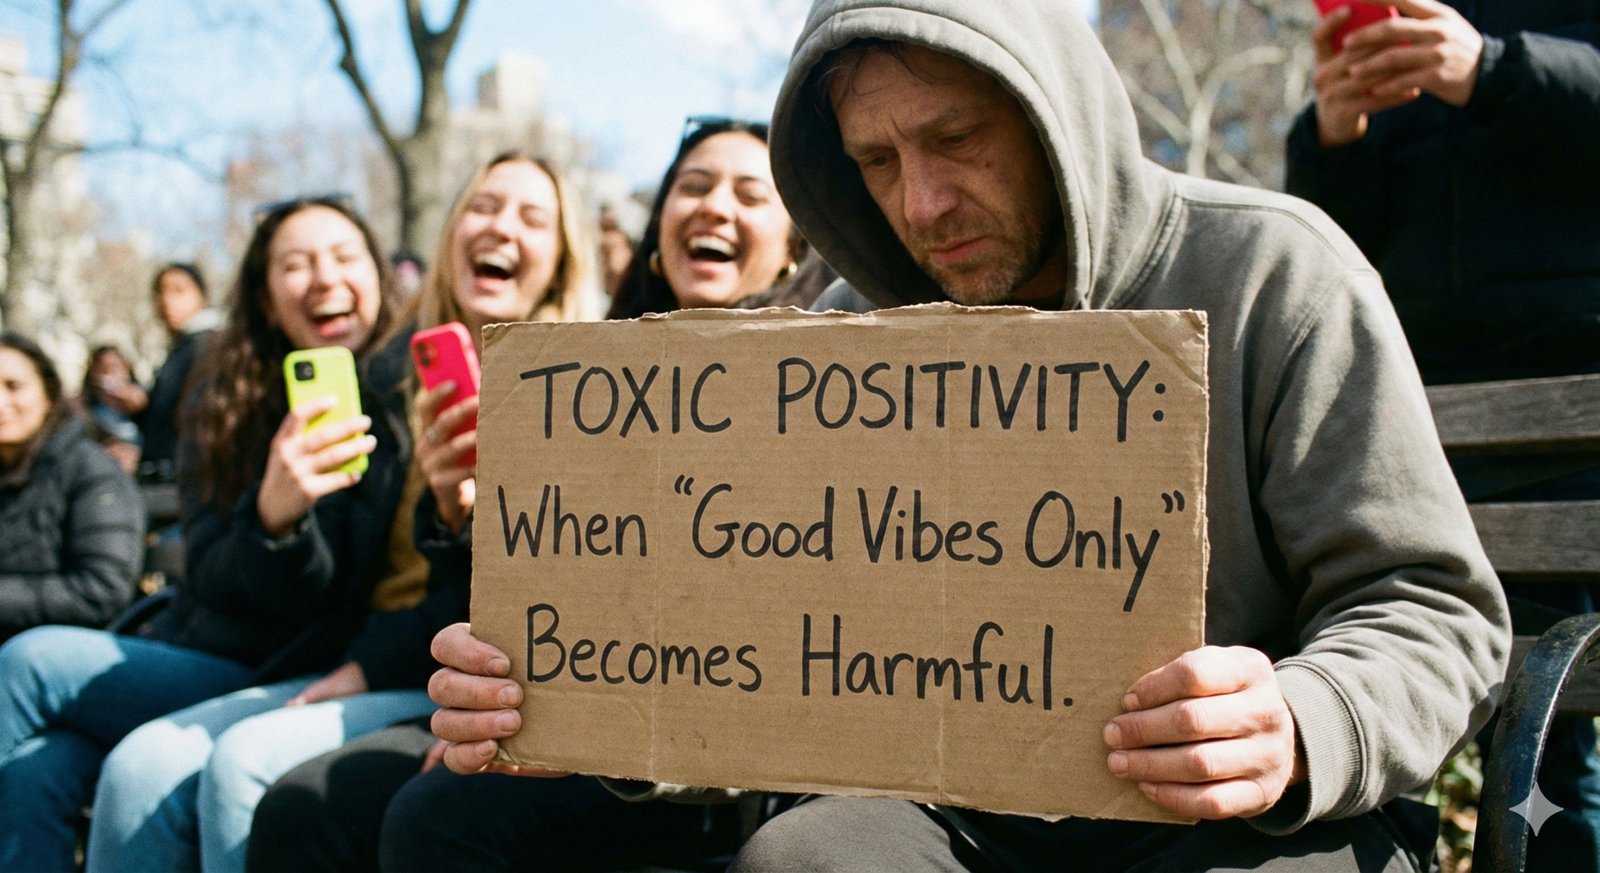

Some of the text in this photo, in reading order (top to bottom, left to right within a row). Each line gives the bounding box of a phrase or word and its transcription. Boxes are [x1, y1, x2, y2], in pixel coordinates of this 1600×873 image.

[520, 357, 1167, 443] TOXIC POSITIVITY:
[497, 474, 1186, 613] When “Good Vibes Only”
[526, 603, 1075, 711] Becomes Harmful.
